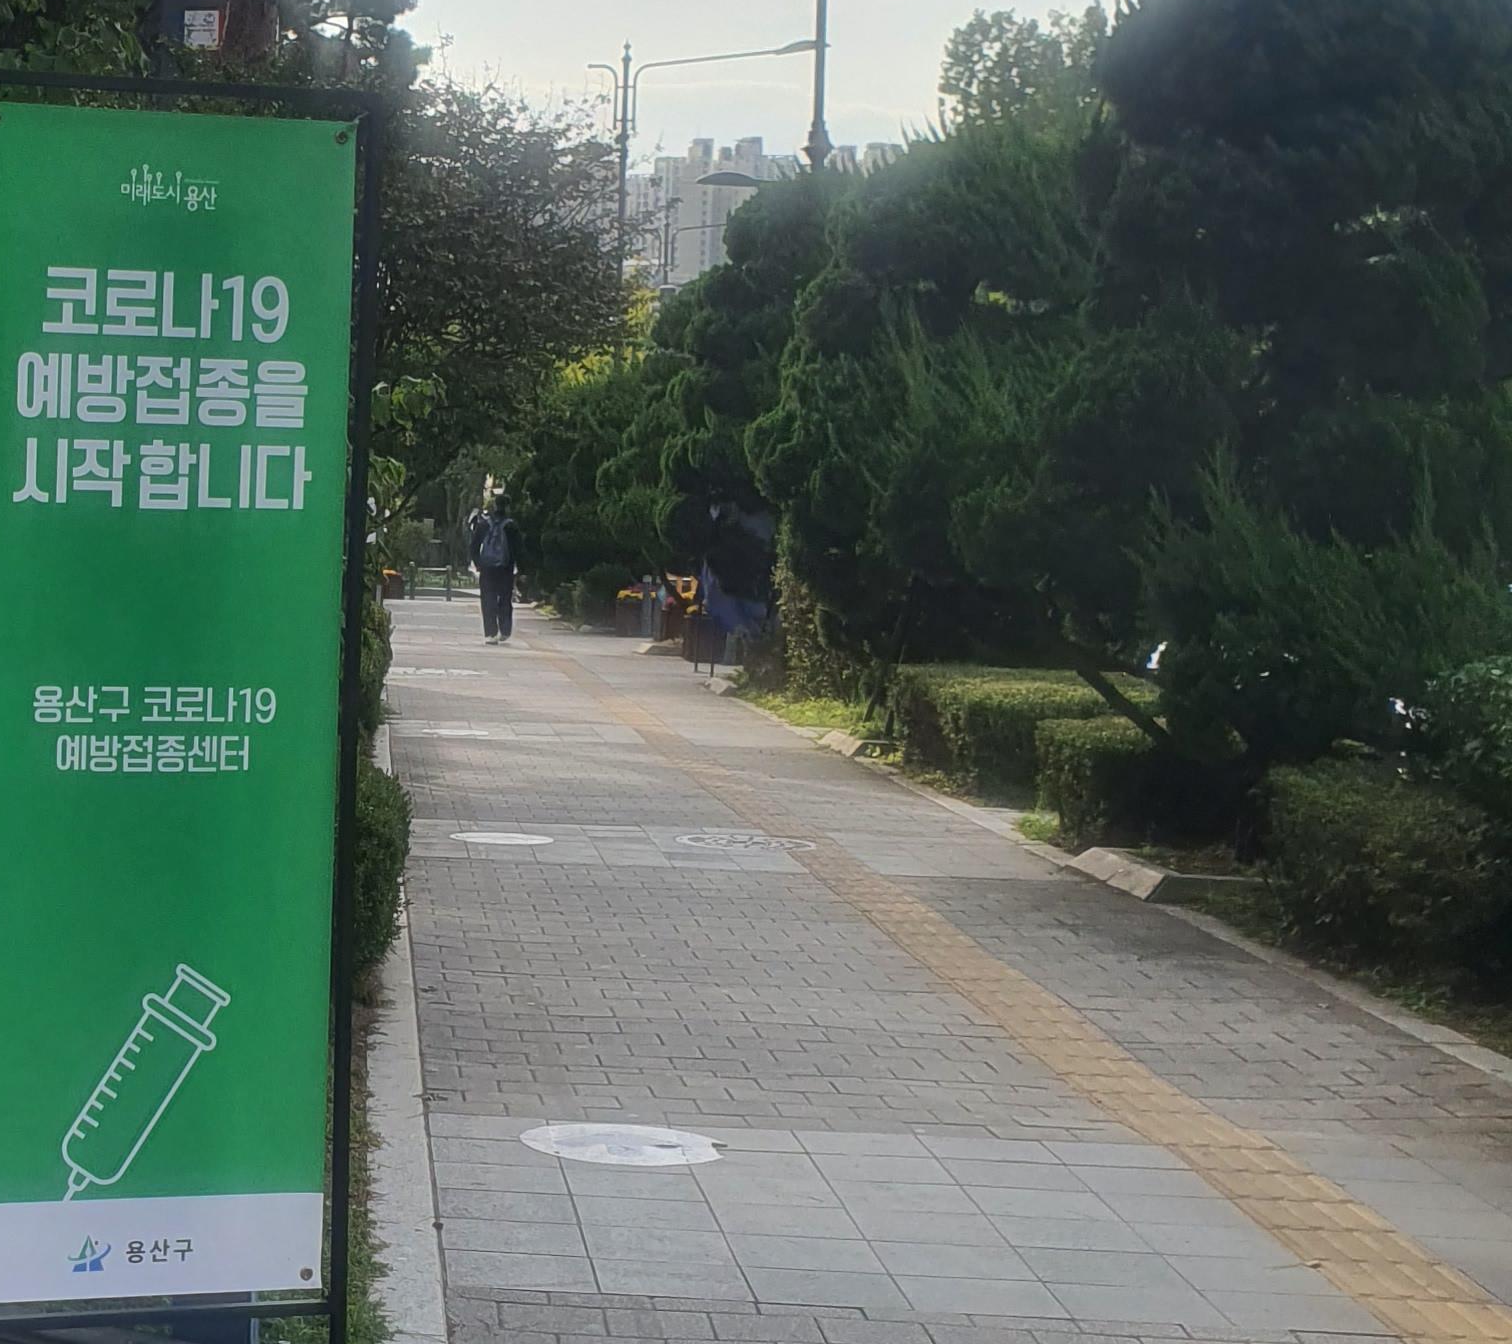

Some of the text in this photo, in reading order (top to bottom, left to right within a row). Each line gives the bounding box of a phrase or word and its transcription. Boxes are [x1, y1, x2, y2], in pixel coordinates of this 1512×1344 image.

[120, 164, 218, 212] 미래도시 용산
[42, 265, 290, 344] 코로나19
[16, 352, 308, 428] 예방접종을
[12, 437, 312, 510] 시작합니다
[32, 685, 277, 724] 용산구 코로나19
[55, 734, 250, 773] 예방접종센터
[125, 1238, 195, 1265] 용산구
